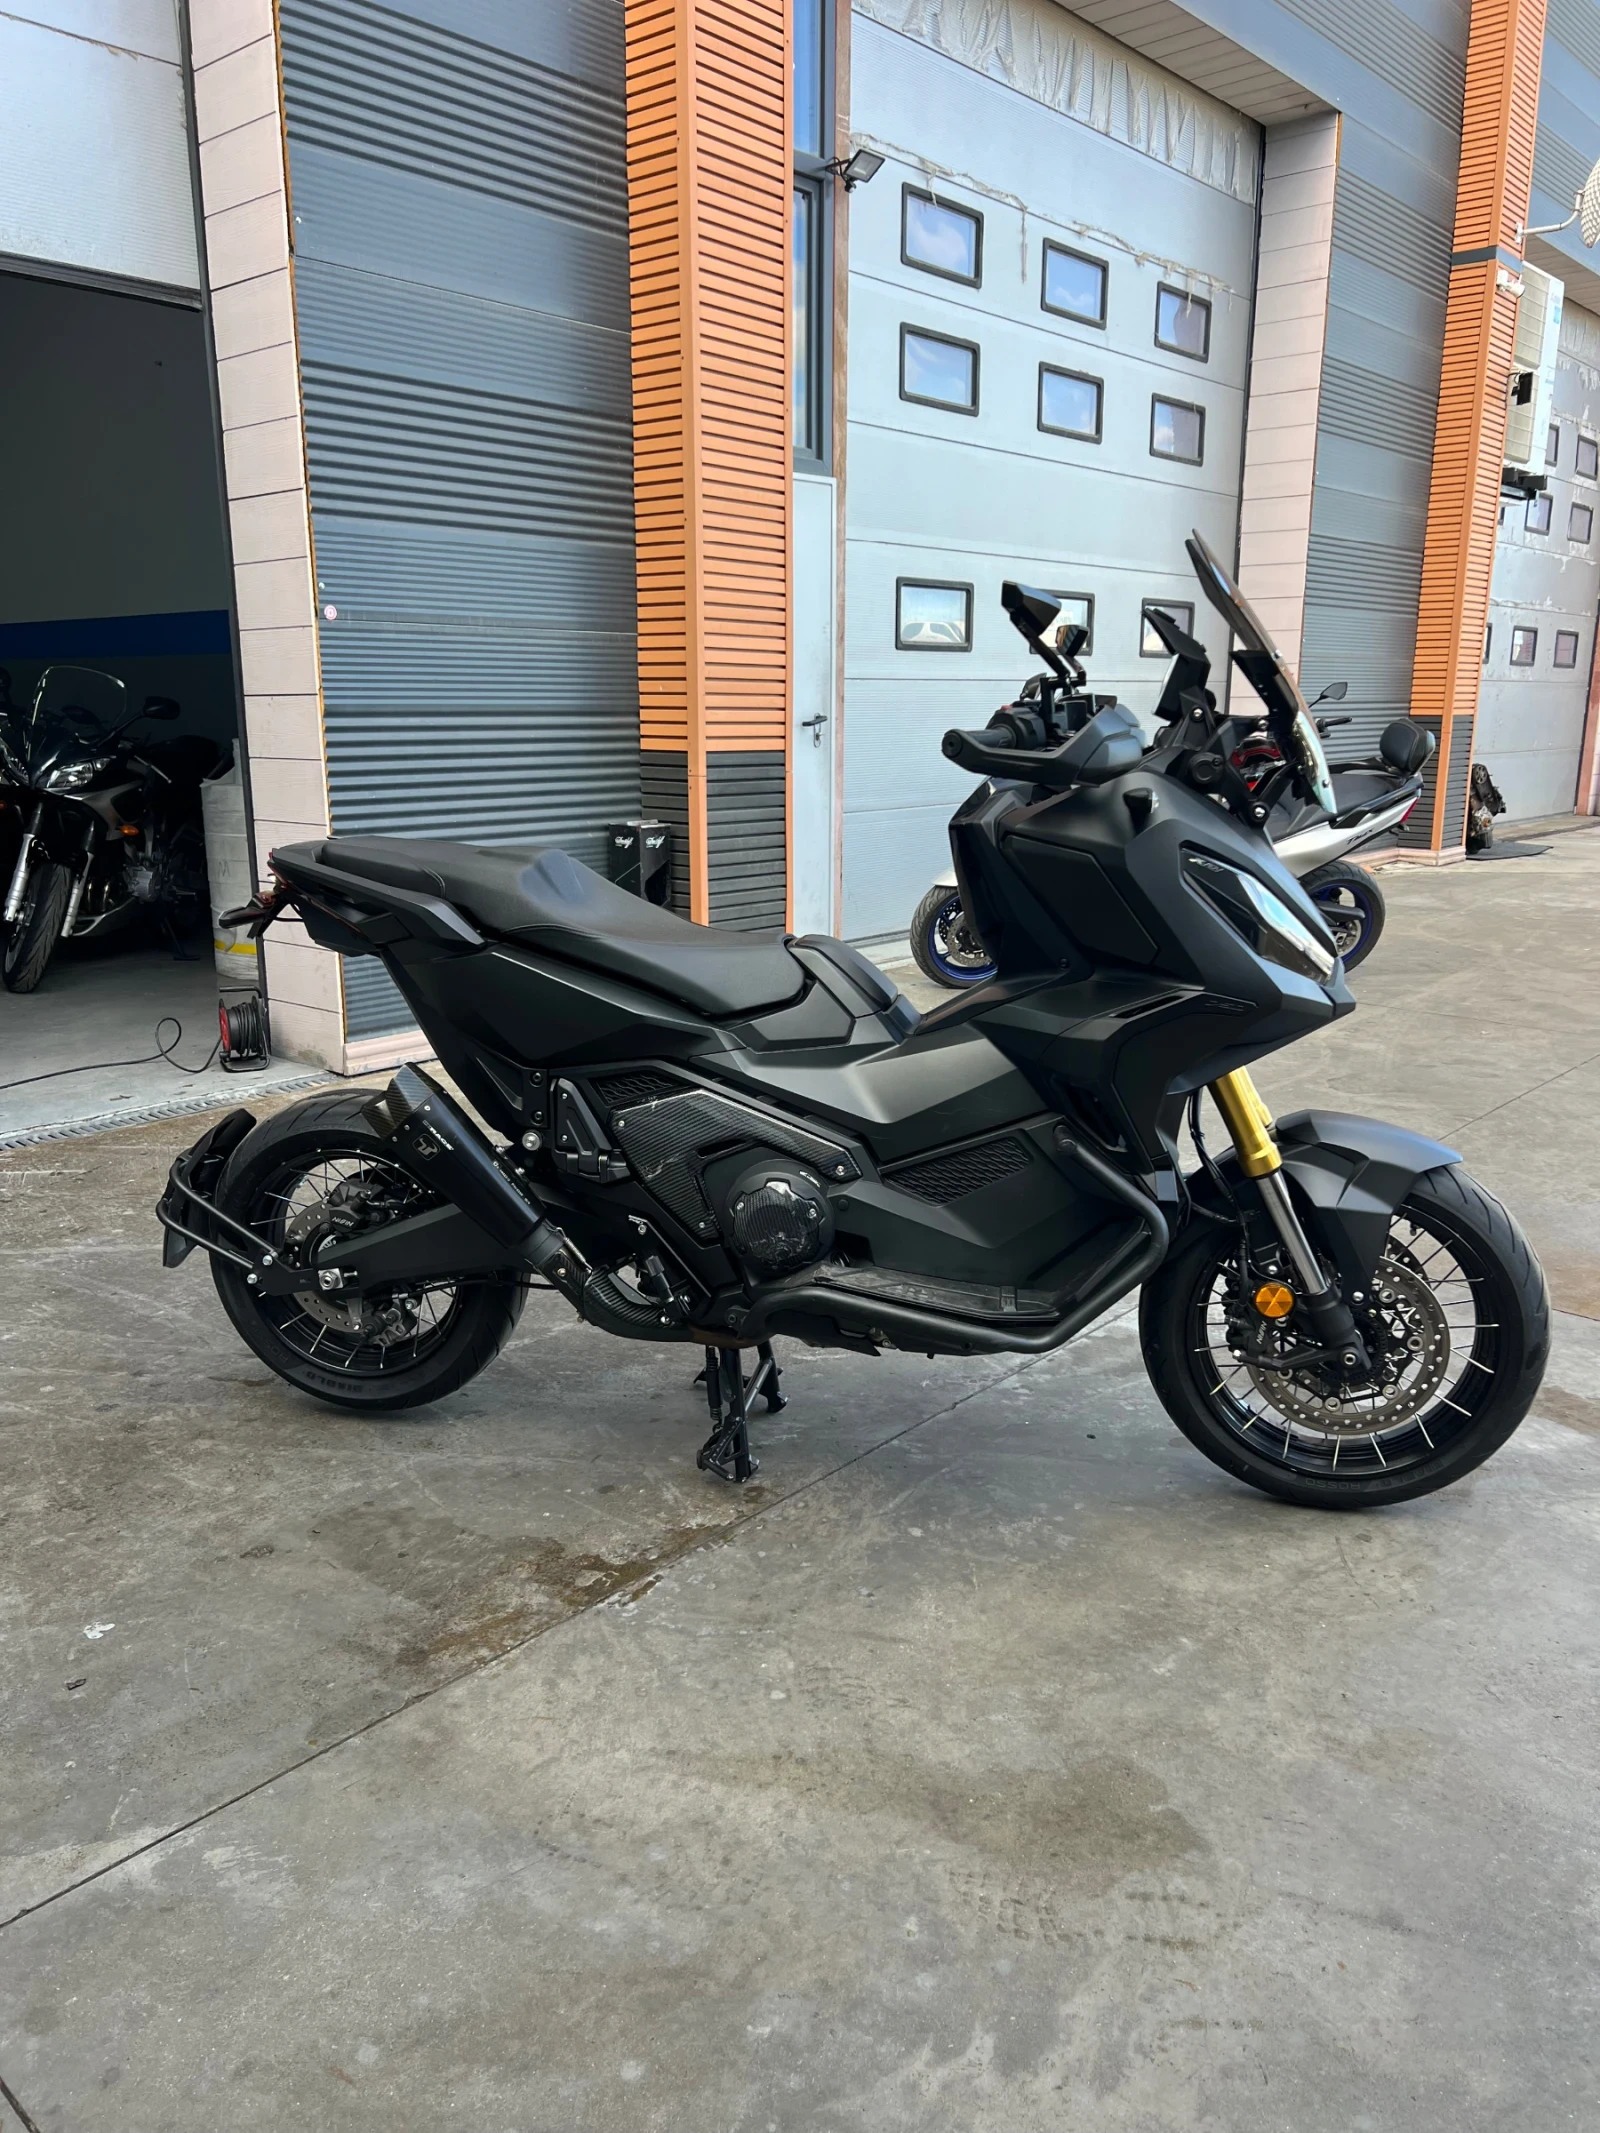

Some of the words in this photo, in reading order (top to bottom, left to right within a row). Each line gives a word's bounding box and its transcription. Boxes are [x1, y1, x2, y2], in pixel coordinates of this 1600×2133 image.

[332, 1216, 355, 1228] NISSIN
[1256, 1320, 1269, 1345] NISSIN
[1305, 1477, 1361, 1491] ROSSO
